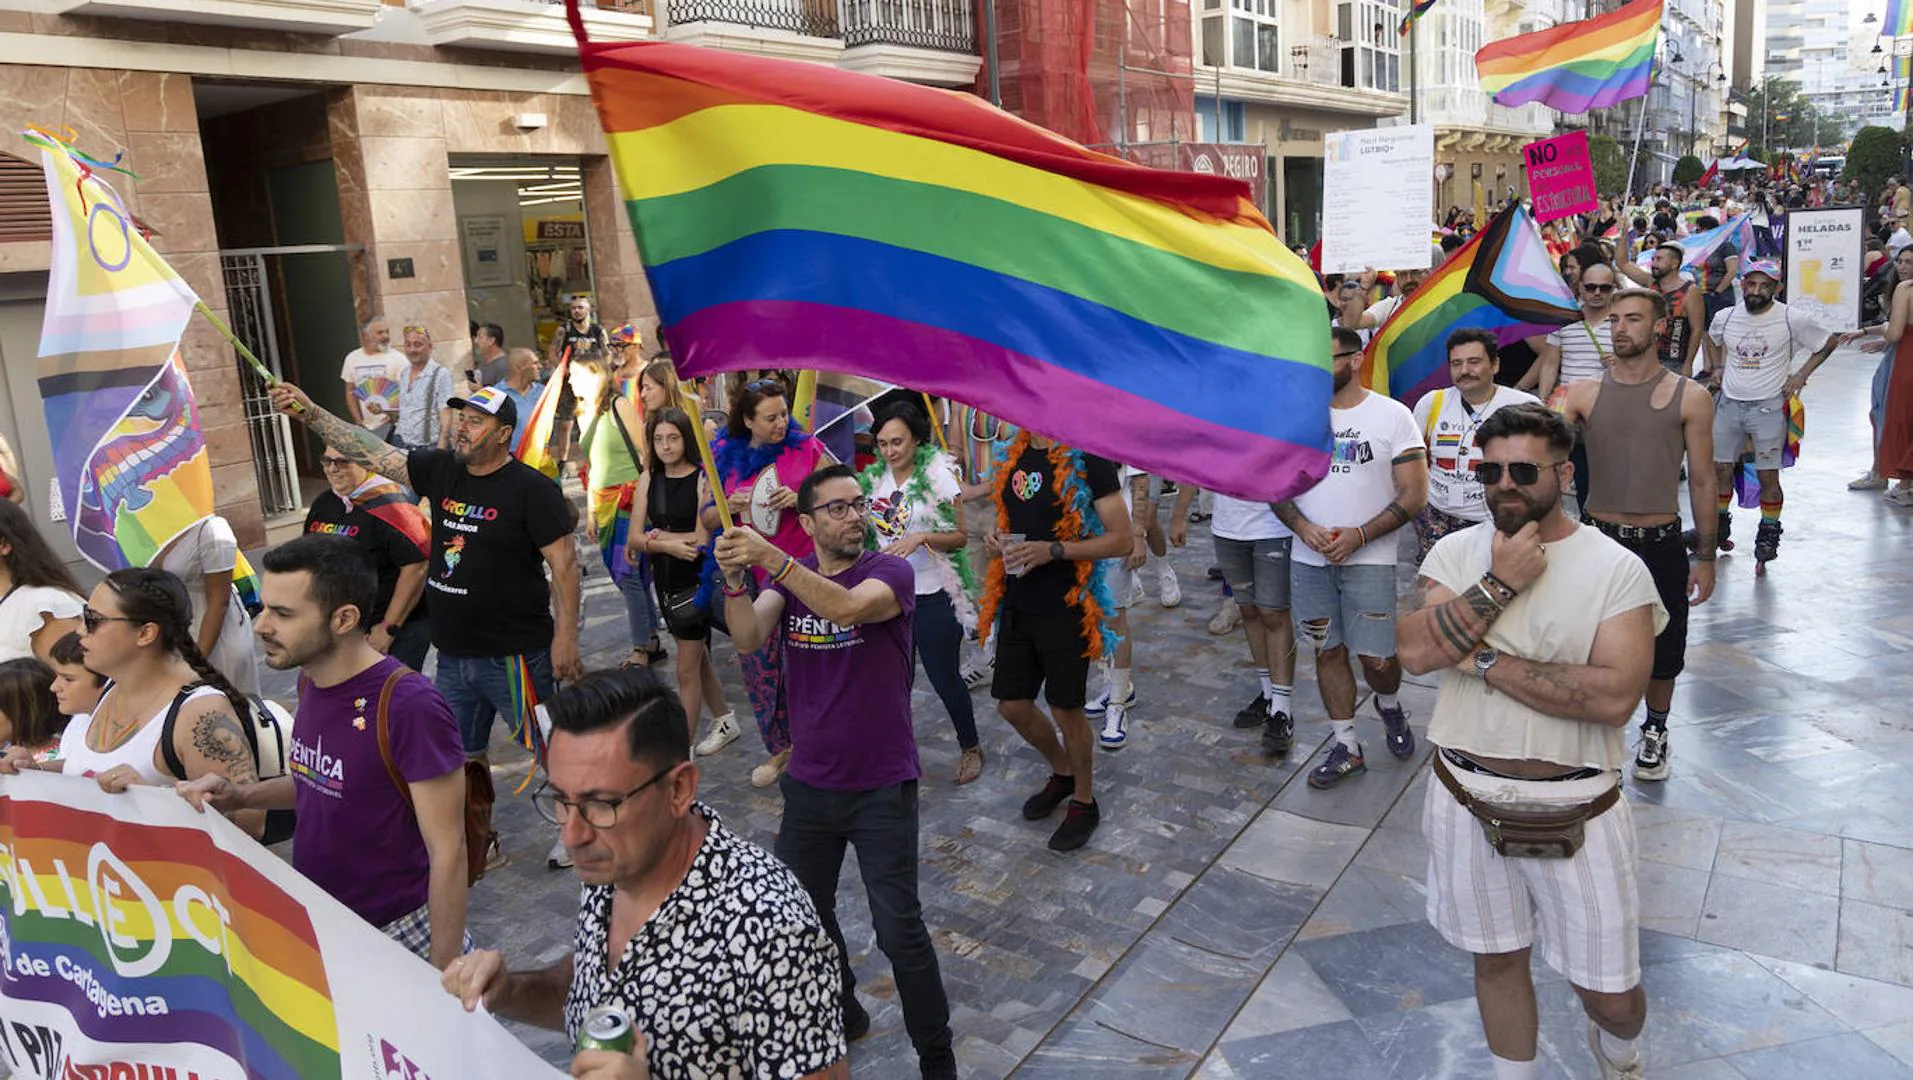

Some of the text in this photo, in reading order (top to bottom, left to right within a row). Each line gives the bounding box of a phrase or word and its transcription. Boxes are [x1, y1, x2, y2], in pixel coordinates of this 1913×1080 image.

[1529, 143, 1557, 166] NO
[544, 221, 581, 237] ESTA
[1797, 223, 1852, 233] HELADAS
[16, 952, 169, 1018] de Cartagena
